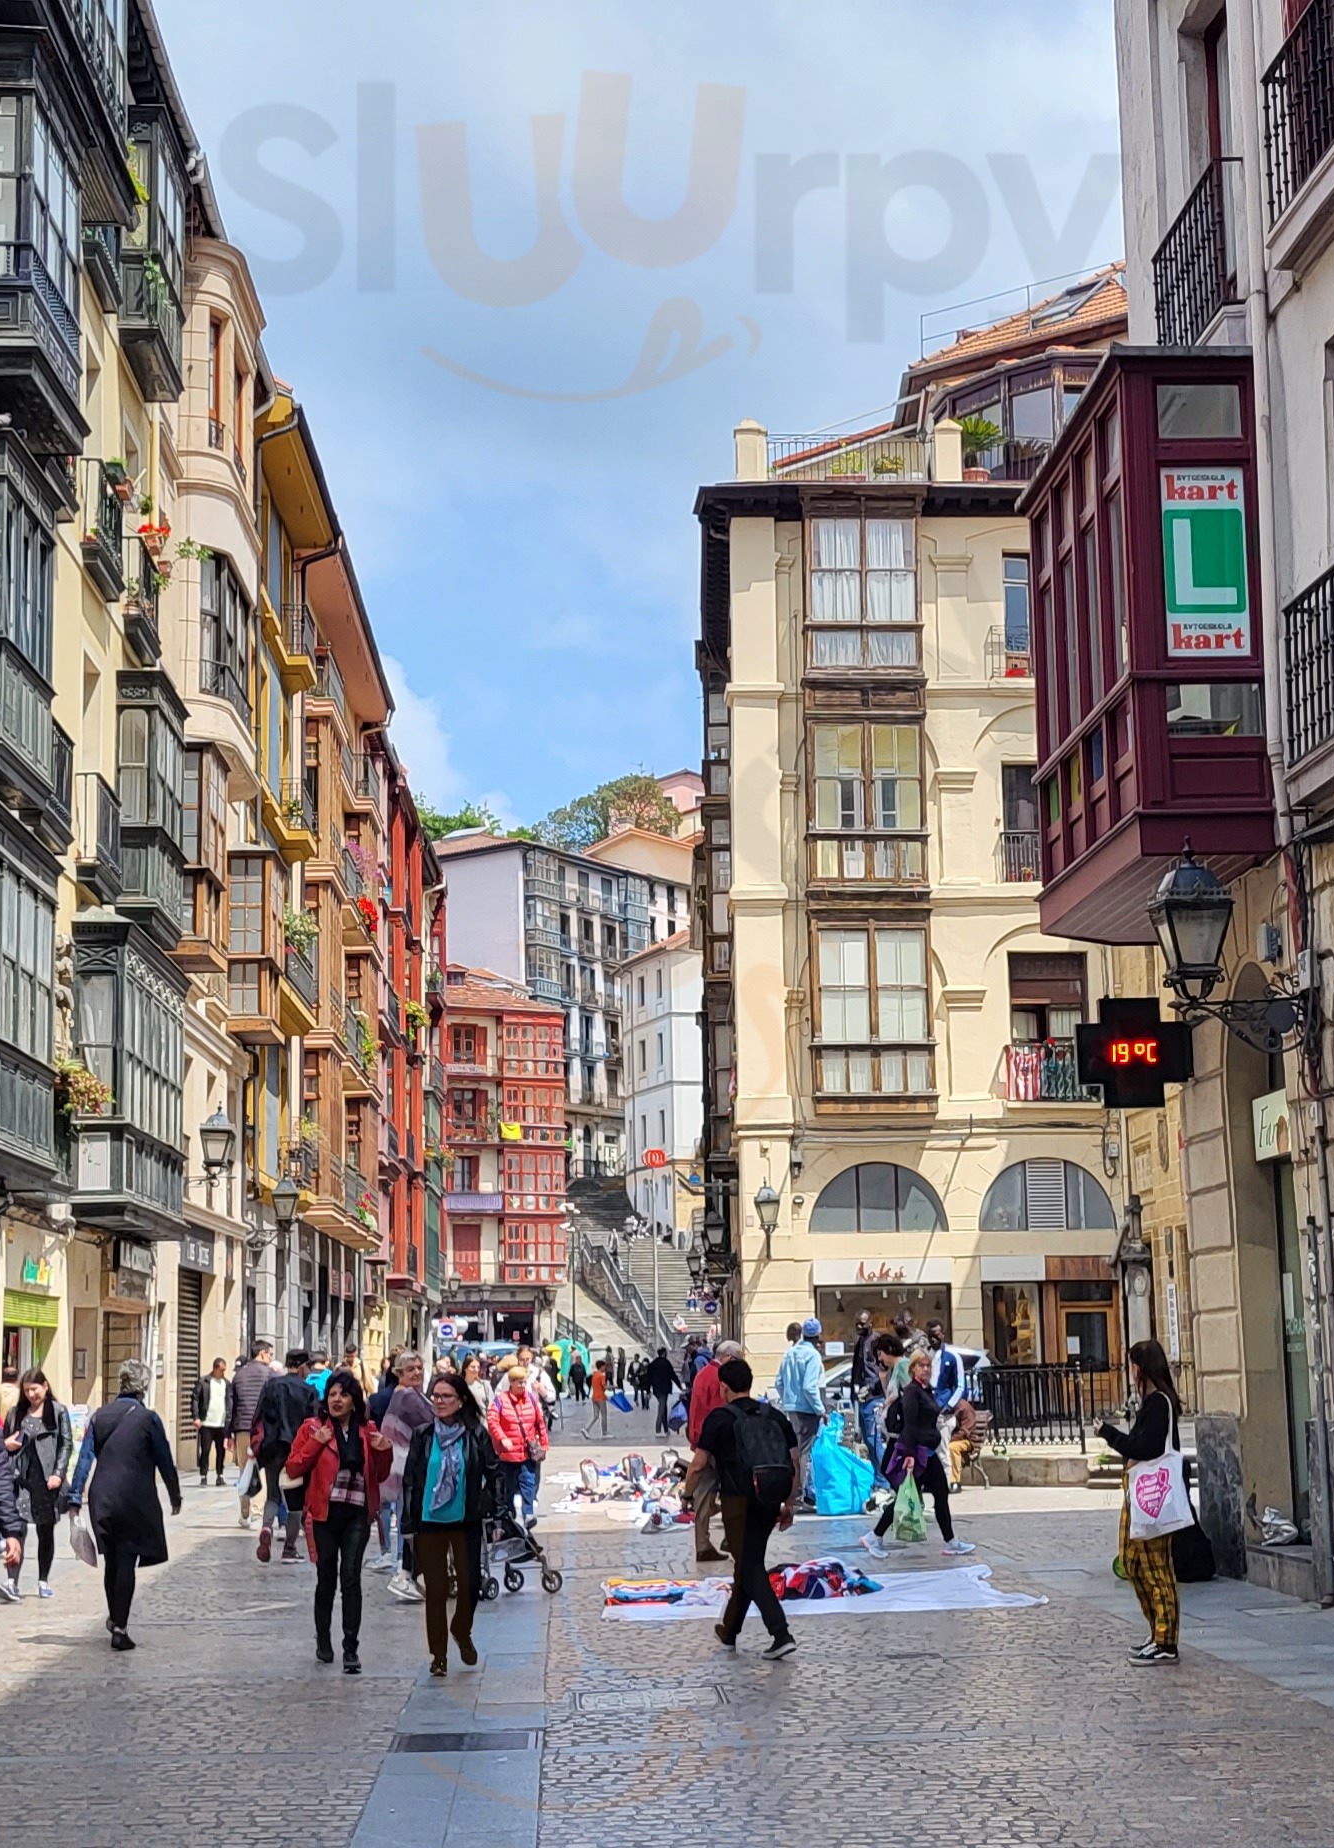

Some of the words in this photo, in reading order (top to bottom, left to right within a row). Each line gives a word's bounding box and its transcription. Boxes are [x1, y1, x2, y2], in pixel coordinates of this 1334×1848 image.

[1164, 474, 1238, 500] kart
[1172, 518, 1238, 606] L
[1171, 623, 1245, 650] kart
